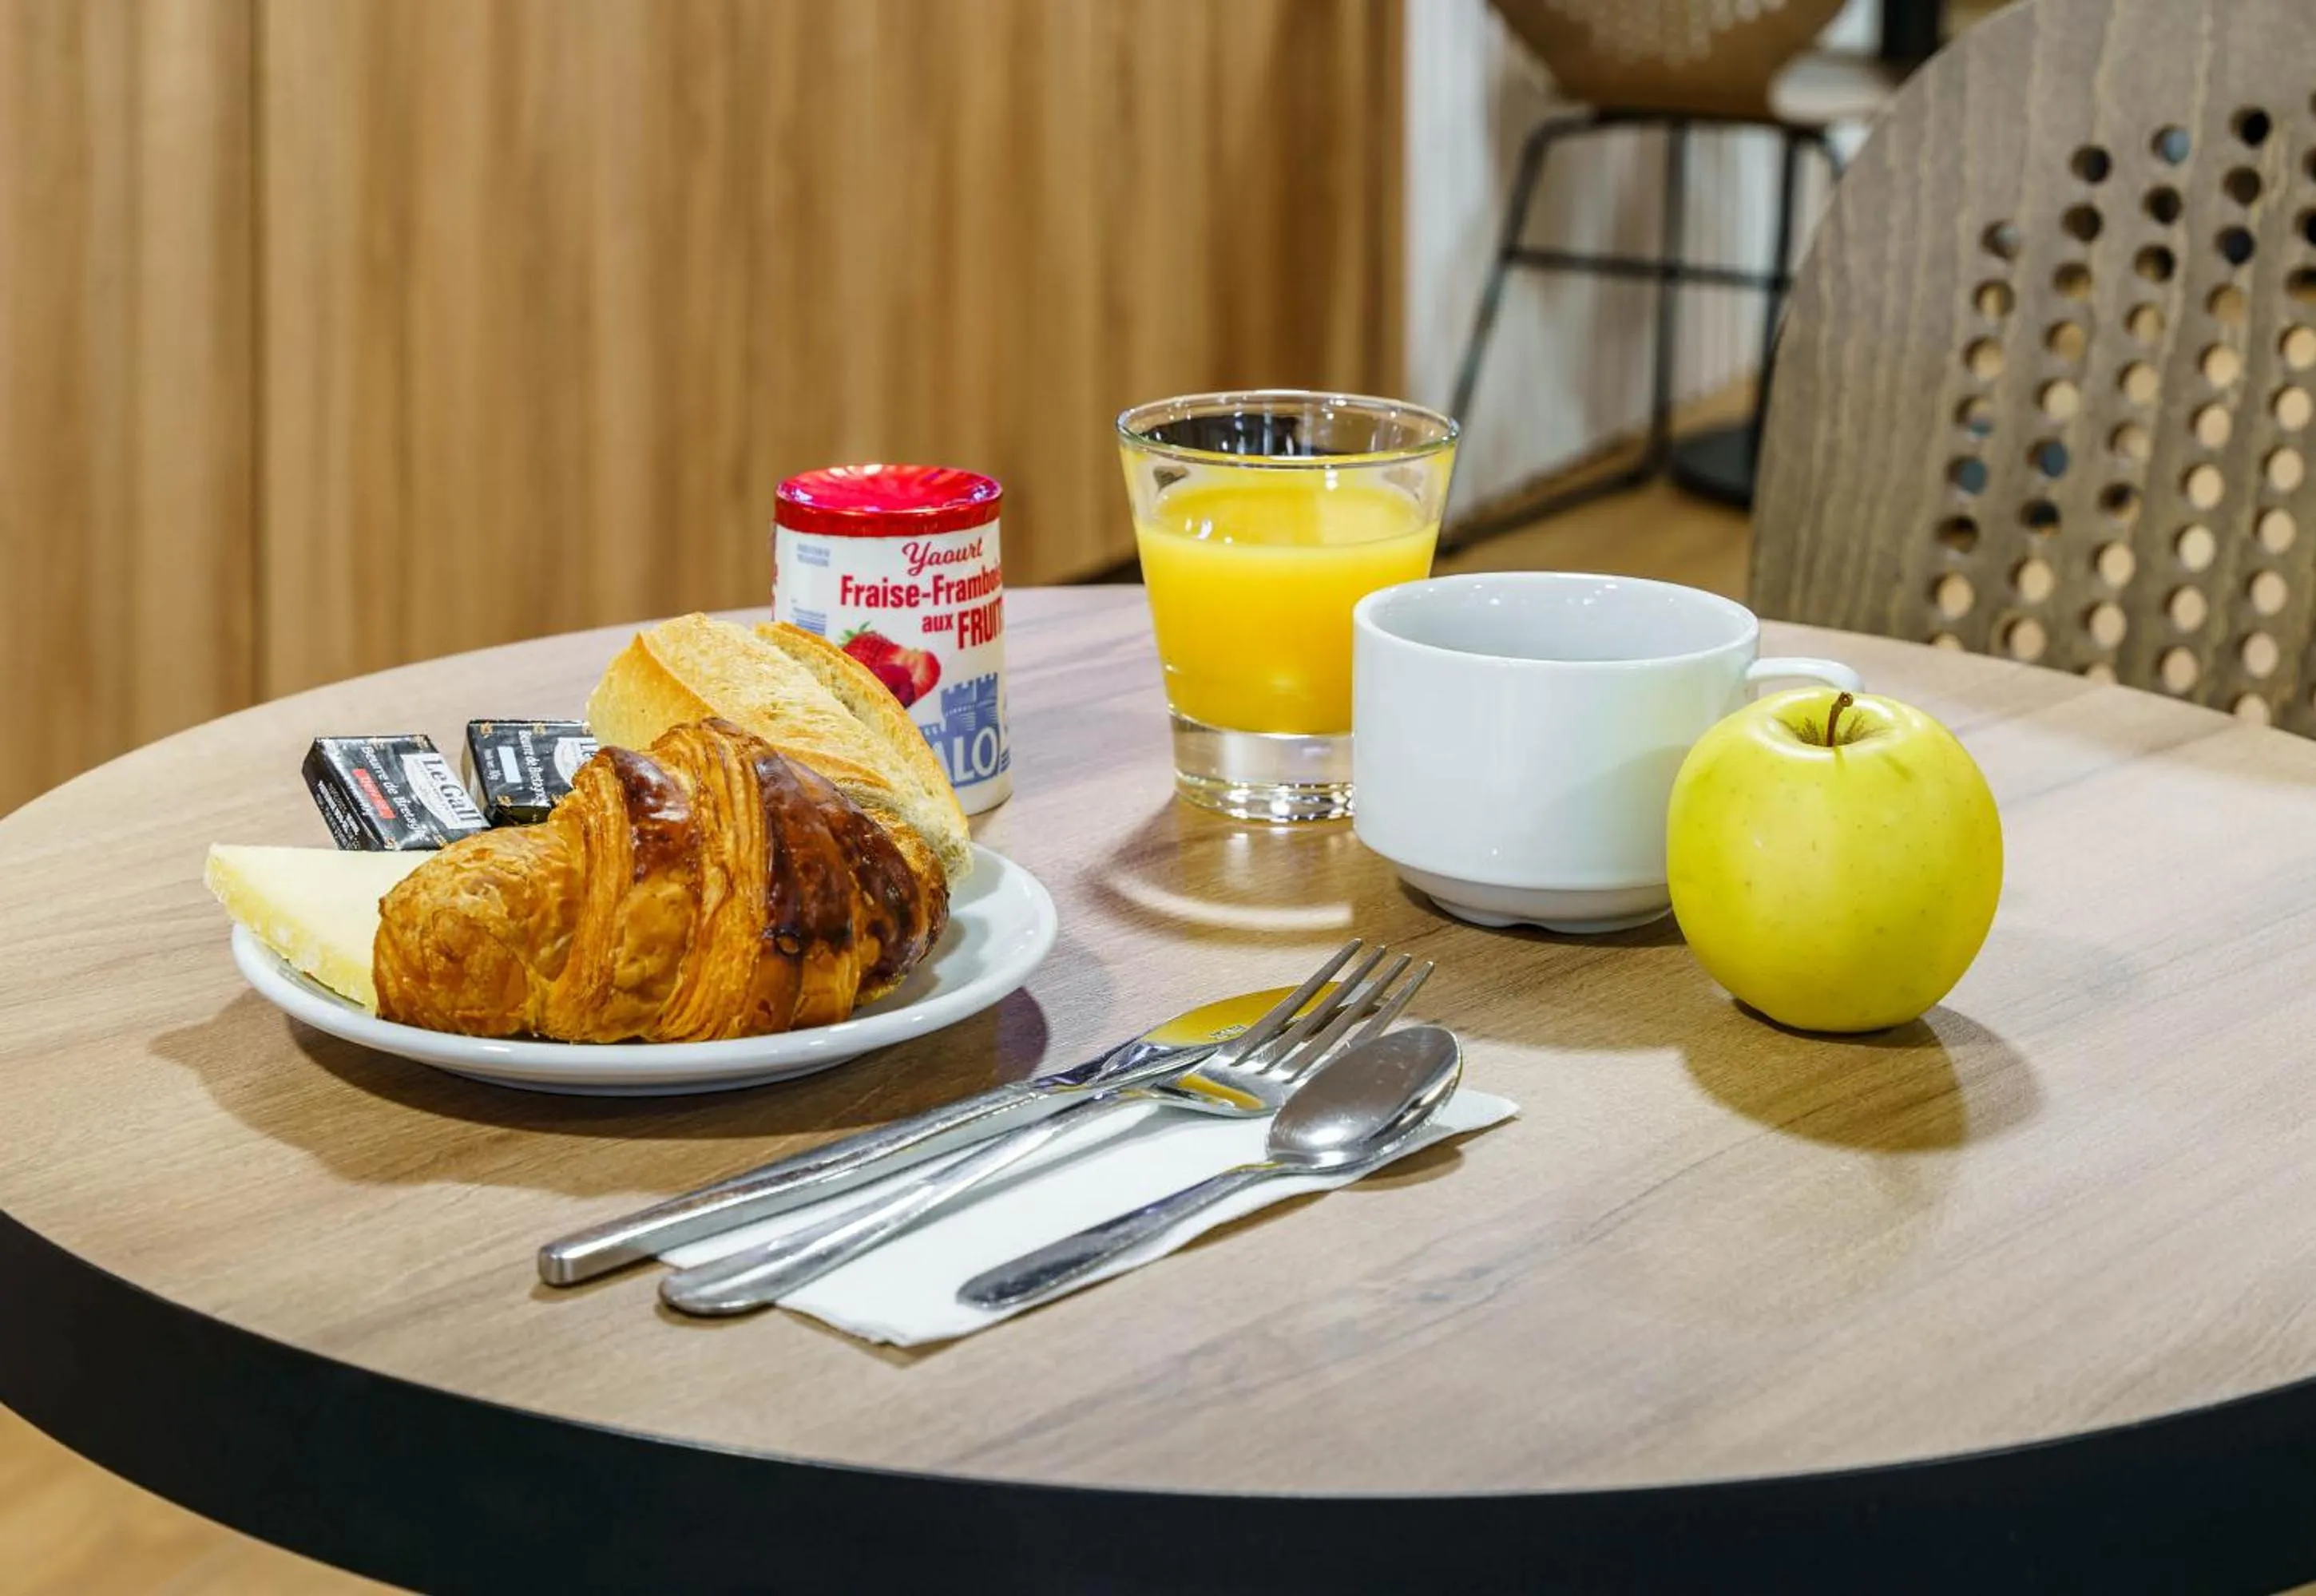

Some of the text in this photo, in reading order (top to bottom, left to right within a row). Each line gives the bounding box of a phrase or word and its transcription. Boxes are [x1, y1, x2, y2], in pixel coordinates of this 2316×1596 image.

[902, 537, 982, 576] Yaourt
[922, 613, 954, 633] aux
[422, 760, 447, 782] Le
[383, 782, 399, 795] de
